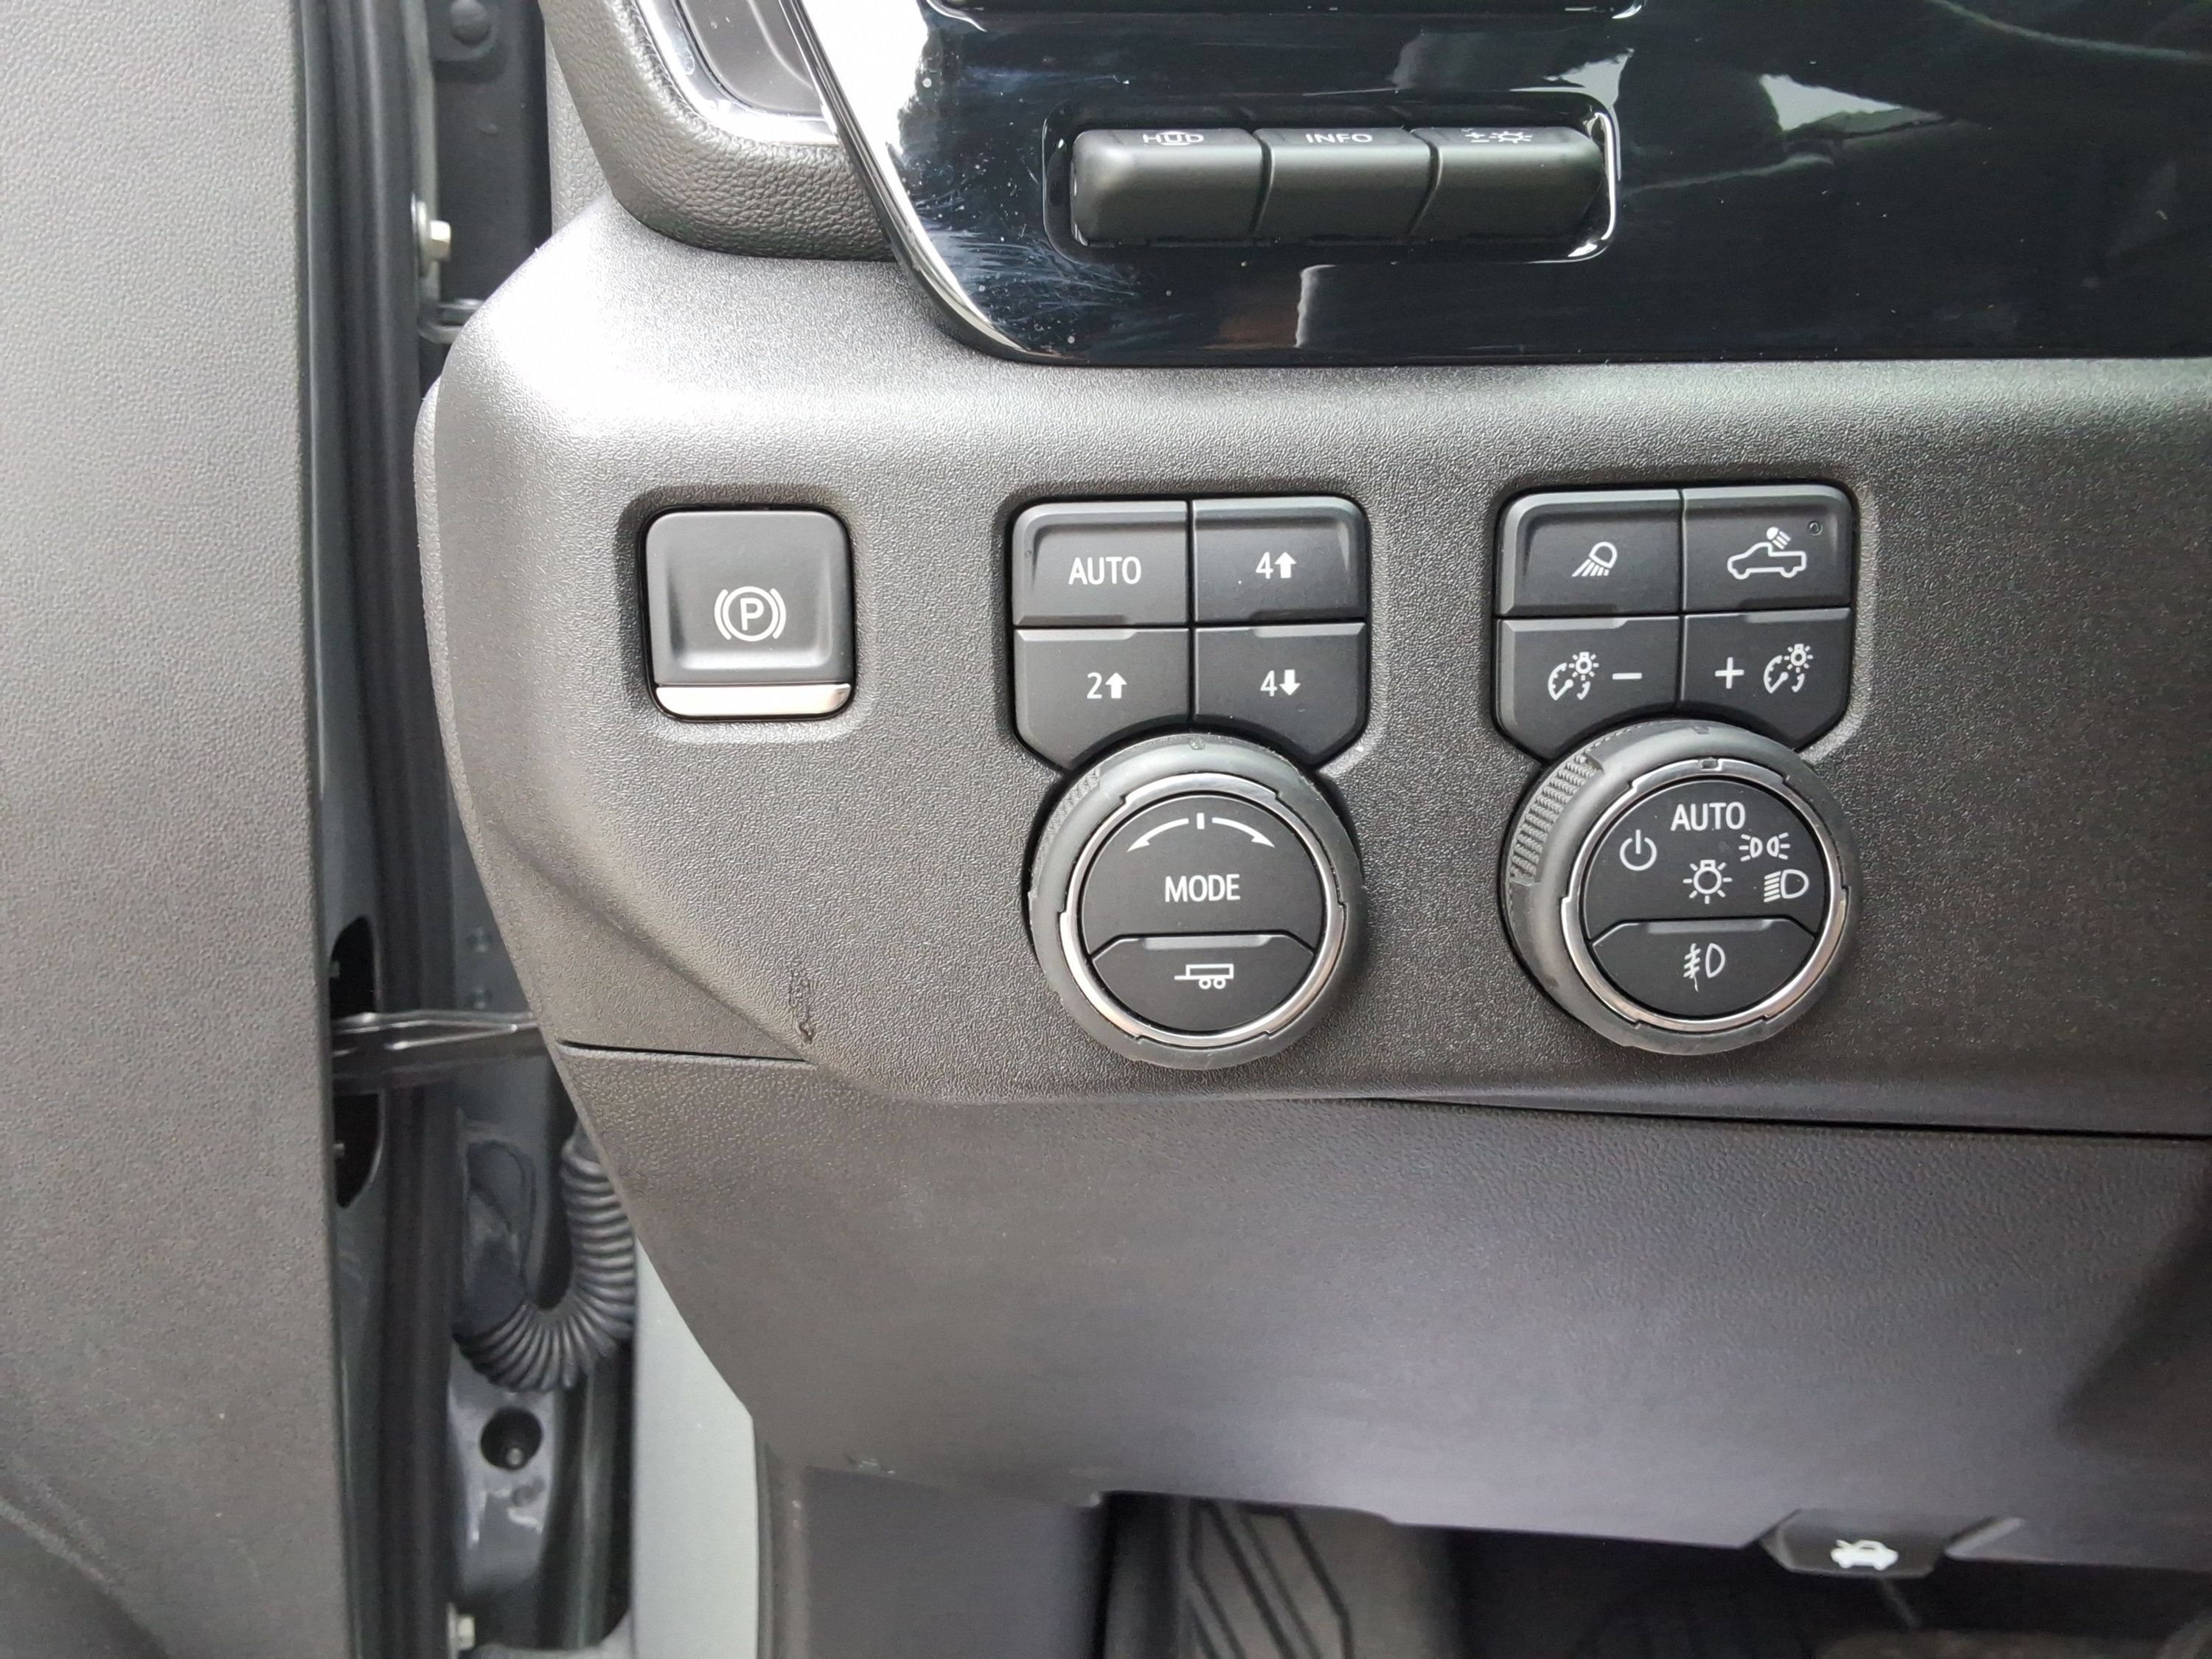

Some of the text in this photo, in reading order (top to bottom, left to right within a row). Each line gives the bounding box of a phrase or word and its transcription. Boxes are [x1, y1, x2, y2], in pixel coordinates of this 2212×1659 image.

[1142, 133, 1204, 143] HUD
[1305, 133, 1373, 143] INFO
[1068, 556, 1141, 585] AUTO
[1256, 552, 1274, 579] 4
[740, 597, 765, 631] P
[1086, 672, 1103, 699] 2
[1260, 670, 1278, 697] 4
[1671, 801, 1745, 832] AUTO
[1164, 874, 1241, 903] MODE
